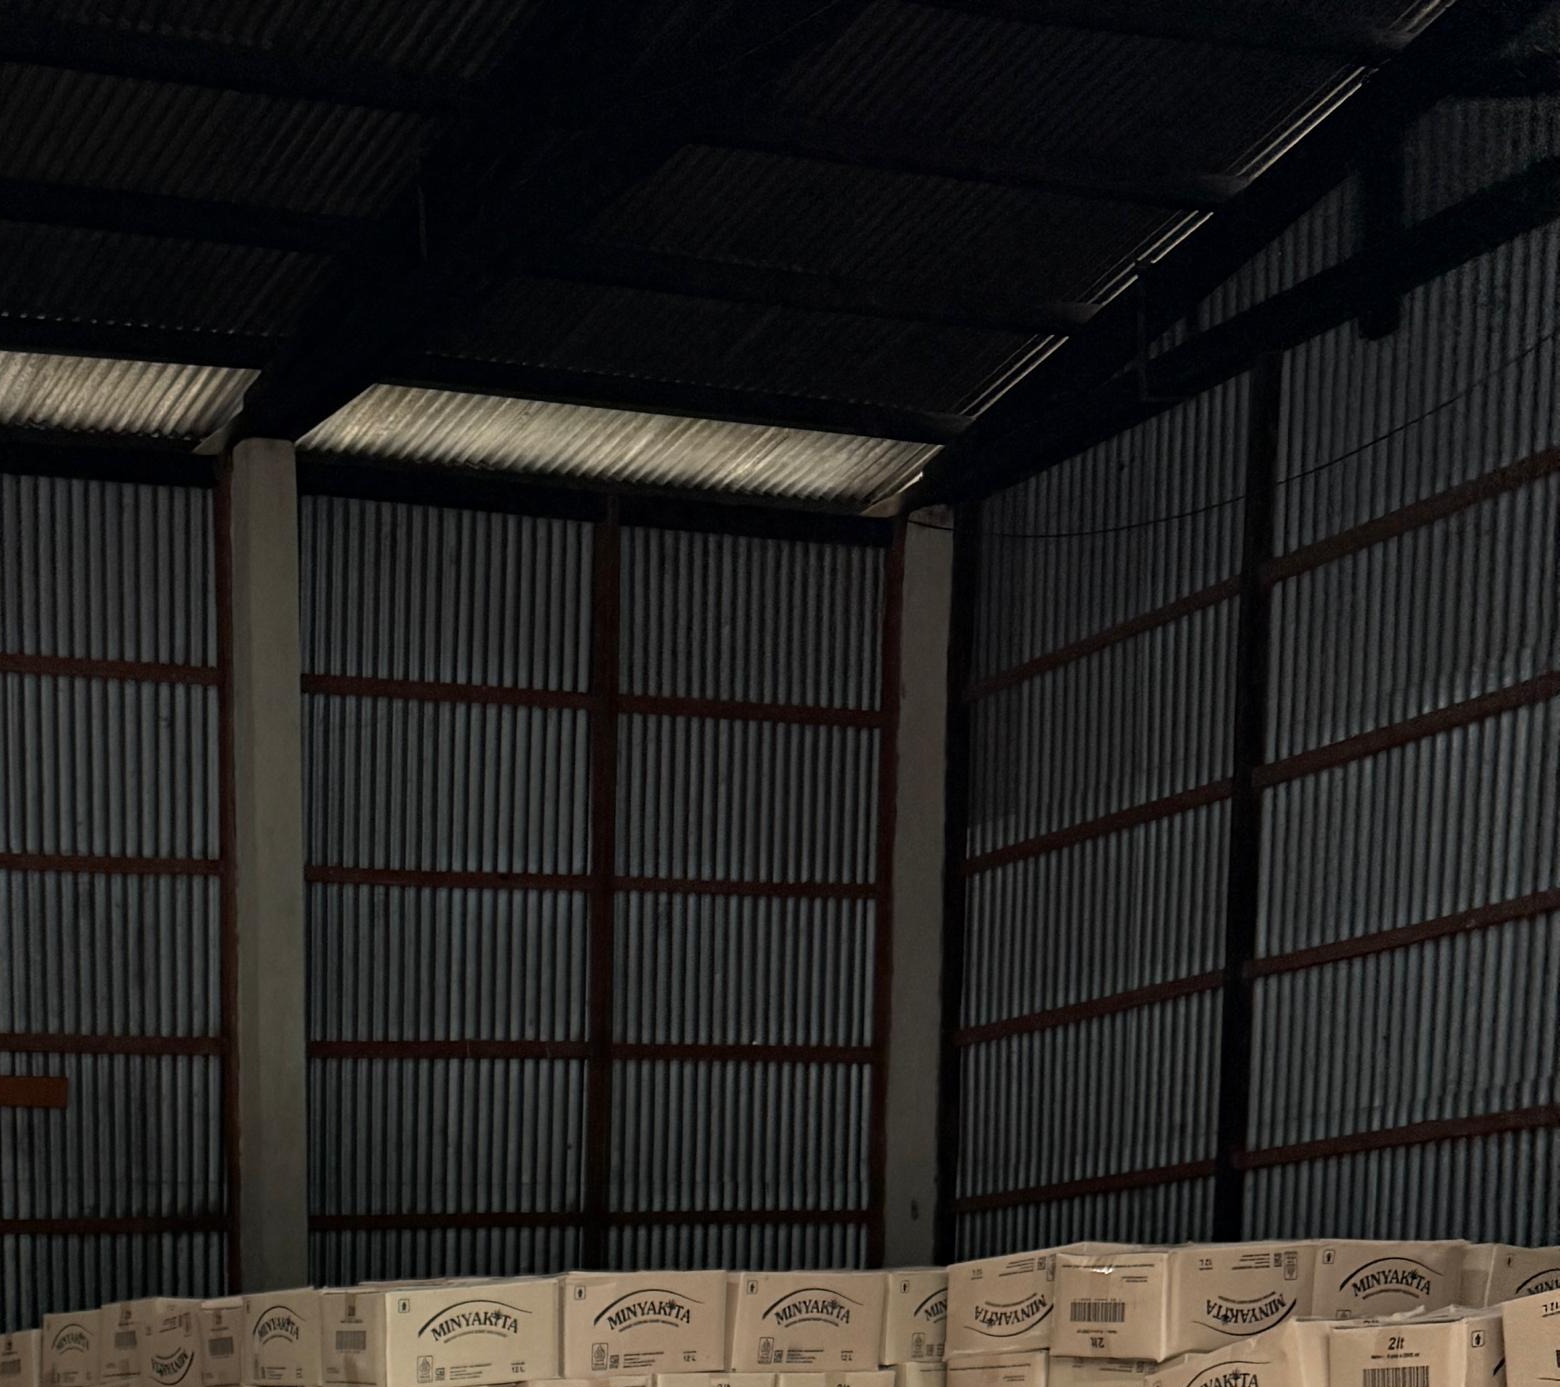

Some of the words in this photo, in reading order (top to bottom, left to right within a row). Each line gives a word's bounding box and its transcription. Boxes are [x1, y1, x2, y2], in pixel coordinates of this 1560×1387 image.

[1351, 1268, 1433, 1298] MINYAKITA
[607, 1300, 691, 1331] MINYAKITA
[774, 1299, 852, 1326] MINYAKITA
[974, 1293, 1048, 1326] MINYAKITA
[1206, 1292, 1287, 1325] MINYAKITA
[430, 1309, 520, 1342] MINYAKITA
[1388, 1336, 1405, 1351] 2lt
